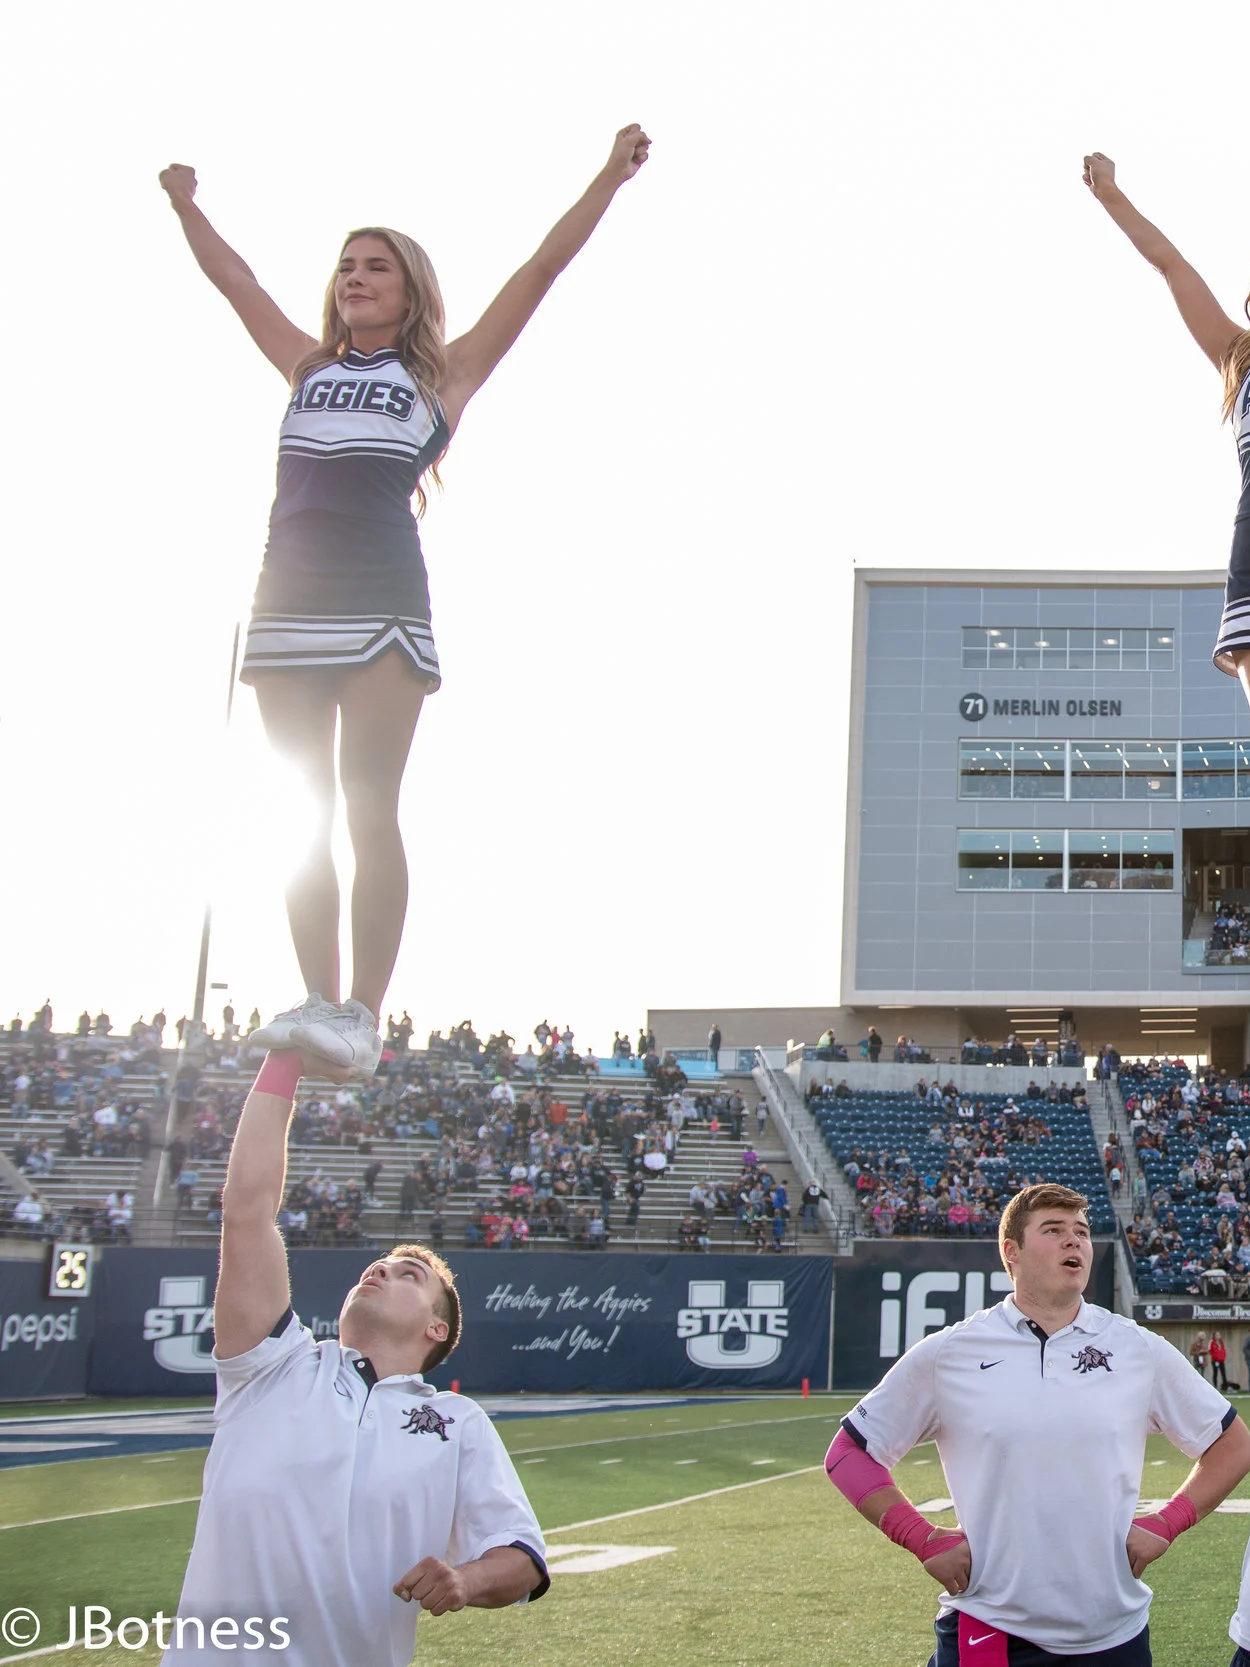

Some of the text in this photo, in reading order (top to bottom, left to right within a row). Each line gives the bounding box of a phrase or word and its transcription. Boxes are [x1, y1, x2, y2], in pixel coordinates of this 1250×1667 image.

[282, 379, 417, 422] AGGIES
[963, 698, 1122, 716] 71 MERLIN OLSEN
[56, 1251, 87, 1289] 25
[486, 1283, 652, 1320] Healing the Aggies
[1192, 1304, 1231, 1317] Discount
[2, 1306, 79, 1350] pepsi
[677, 1308, 789, 1338] STATE
[566, 1324, 621, 1361] You!
